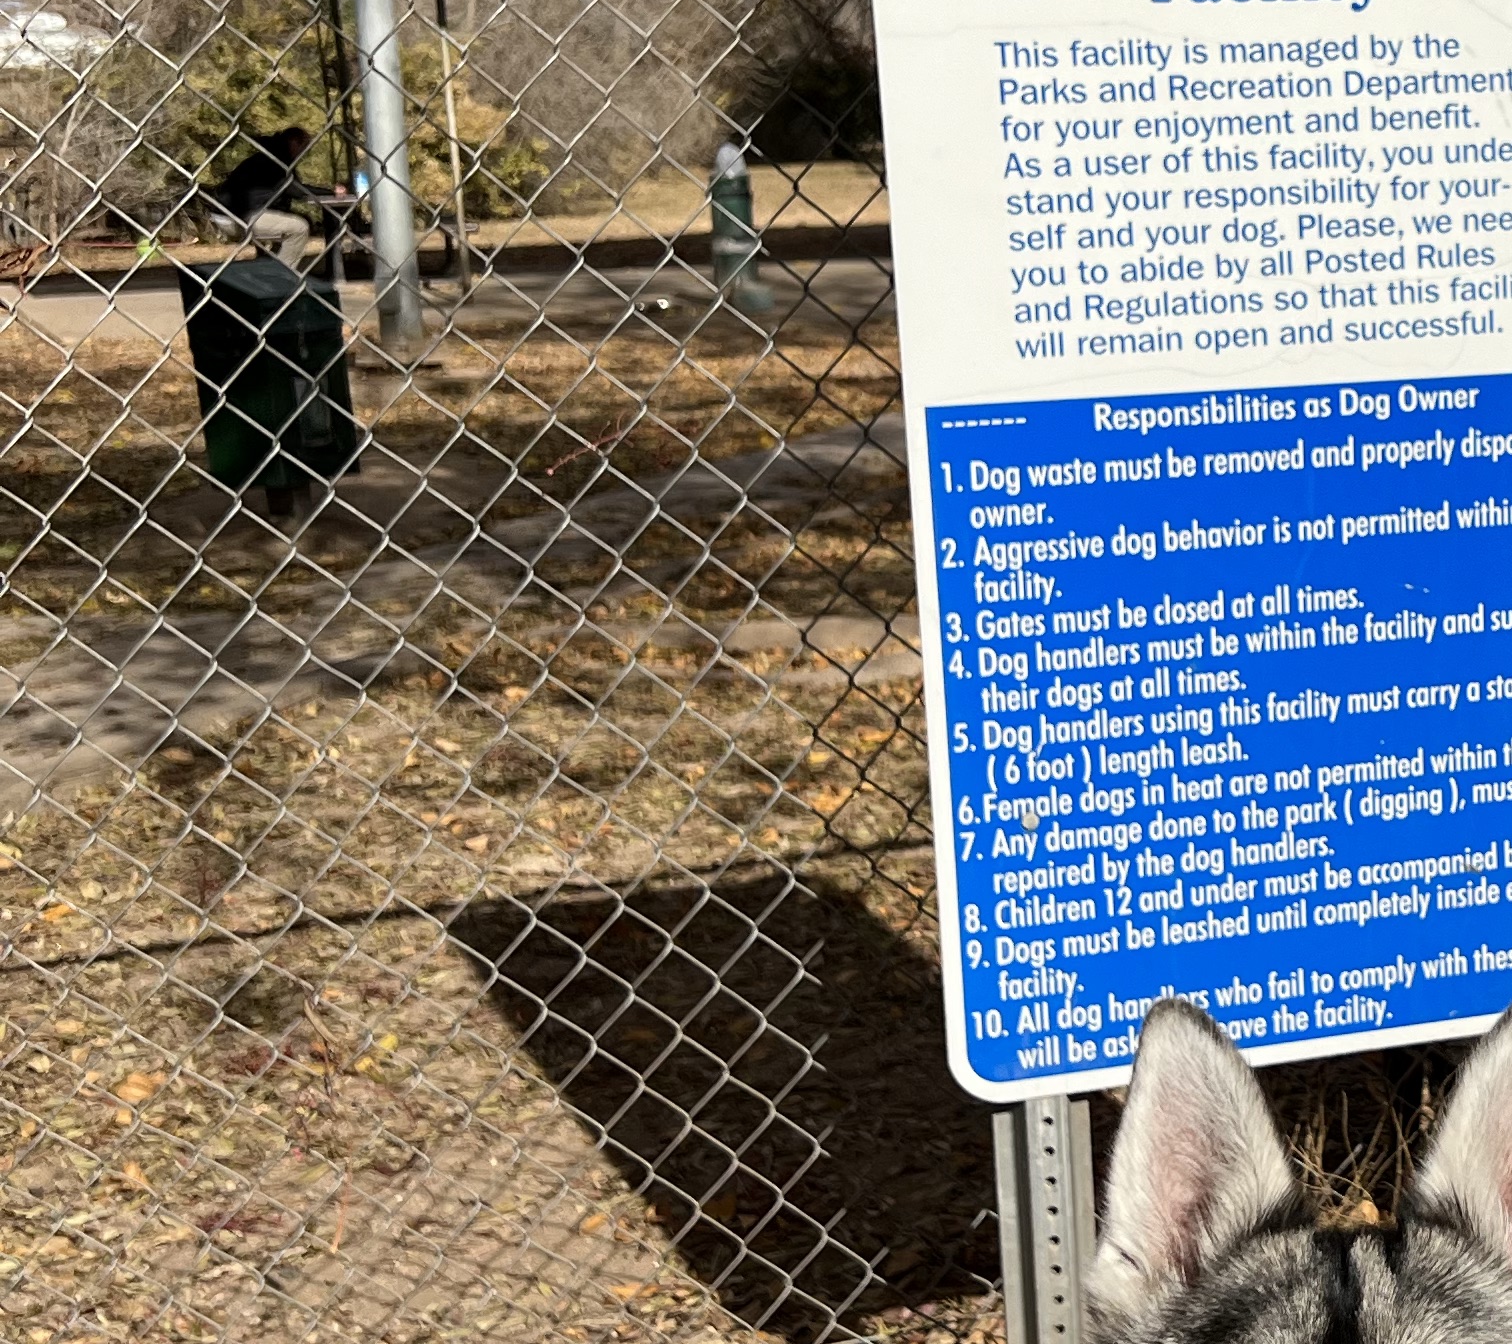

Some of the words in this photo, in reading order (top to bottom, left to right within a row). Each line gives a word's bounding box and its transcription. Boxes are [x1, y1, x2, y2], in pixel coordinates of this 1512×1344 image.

[992, 40, 1059, 68] This
[1068, 38, 1173, 72] facility
[1183, 37, 1208, 64] is
[1219, 34, 1358, 68] managed
[1369, 33, 1403, 66] by
[1411, 32, 1460, 59] the
[998, 77, 1088, 106] Parks
[1098, 74, 1156, 103] and
[1168, 72, 1332, 101] Recreation
[999, 114, 1044, 143] for
[1054, 118, 1123, 148] your
[1133, 109, 1294, 144] enjoyment
[1304, 105, 1359, 133] and
[1370, 102, 1480, 132] benefit.
[1003, 151, 1042, 179] As
[1053, 156, 1072, 178] a
[1083, 154, 1152, 177] user
[1162, 146, 1193, 174] of
[1201, 145, 1259, 173] this
[1268, 142, 1375, 174] facility,
[1381, 145, 1433, 173] you
[1006, 186, 1094, 216] stand
[1104, 189, 1173, 219] your
[1183, 177, 1380, 214] responsibility
[1389, 174, 1430, 201] for
[1438, 177, 1510, 205] your-
[1008, 222, 1066, 252] self
[1077, 220, 1134, 249] and
[1144, 224, 1212, 253] your
[1222, 216, 1285, 248] dog.
[1297, 213, 1404, 240] Please,
[1411, 214, 1453, 235] we
[1010, 266, 1066, 295] you
[1077, 260, 1109, 285] to
[1120, 254, 1204, 283] abide
[1214, 252, 1249, 285] by
[1259, 250, 1293, 277] all
[1305, 244, 1405, 274] Posted
[1416, 242, 1496, 269] Rules
[1013, 295, 1071, 324] and
[1083, 290, 1264, 325] Regulations
[1274, 290, 1308, 311] so
[1318, 282, 1377, 309] that
[1386, 279, 1440, 306] this
[1015, 331, 1065, 359] will
[1077, 326, 1183, 356] remain
[1194, 326, 1268, 355] open
[1279, 317, 1333, 346] and
[1344, 308, 1503, 342] successful.
[1093, 393, 1296, 435] Responsibilities
[1303, 397, 1332, 418] as
[1339, 388, 1391, 420] Dog
[1398, 384, 1479, 412] Owner
[940, 462, 963, 493] 1.
[969, 460, 1021, 496] Dog
[1027, 458, 1097, 487] waste
[1104, 453, 1162, 482] must
[1166, 447, 1197, 478] be
[1204, 438, 1305, 476] removed
[1311, 435, 1355, 468] and
[1361, 429, 1455, 471] properly
[940, 537, 965, 568] 2.
[973, 531, 1104, 572] Aggressive
[1111, 524, 1157, 560] dog
[1163, 518, 1266, 552] behavior
[1273, 515, 1292, 543] is
[1298, 514, 1335, 541] not
[1341, 500, 1450, 545] permitted
[969, 503, 1054, 529] owner.
[974, 570, 1062, 605] facility.
[946, 612, 969, 643] 3.
[975, 609, 1046, 640] Gates
[1052, 604, 1111, 634] must
[1117, 597, 1147, 628] be
[1153, 589, 1225, 626] closed
[1231, 592, 1255, 619] at
[1261, 584, 1290, 616] all
[1296, 585, 1364, 613] times.
[948, 649, 972, 679] 4.
[978, 647, 1029, 681] Dog
[1035, 636, 1141, 672] handlers
[1147, 633, 1204, 662] must
[1210, 626, 1239, 656] be
[1245, 620, 1316, 653] within
[1322, 615, 1359, 646] the
[1364, 609, 1437, 643] facility
[1442, 602, 1484, 635] and
[981, 681, 1040, 713] their
[1046, 676, 1103, 712] dogs
[1109, 675, 1134, 702] at
[1140, 666, 1170, 699] all
[1177, 667, 1247, 695] times.
[953, 722, 976, 753] 5.
[982, 719, 1033, 756] Dog
[1036, 708, 1144, 751] handlers
[1150, 703, 1213, 736] using
[1219, 695, 1261, 726] this
[1266, 688, 1341, 722] facility
[1347, 685, 1401, 714] must
[1406, 683, 1460, 710] carry
[1466, 681, 1480, 702] a
[964, 903, 988, 933] 8.
[994, 893, 1096, 930] Children
[1103, 885, 1133, 917] 12
[1139, 878, 1183, 913] and
[1190, 872, 1258, 906] under
[1264, 867, 1318, 897] must
[1324, 861, 1352, 889] be
[1357, 841, 1498, 886] accompanied
[966, 939, 990, 969] 9.
[995, 936, 1056, 969] Dogs
[1062, 927, 1120, 957] must
[1126, 919, 1155, 950] be
[1161, 905, 1249, 945] leashed
[1256, 898, 1307, 933] until
[1313, 884, 1431, 926] completely
[1436, 875, 1500, 910] inside
[998, 966, 1084, 1001] facility.
